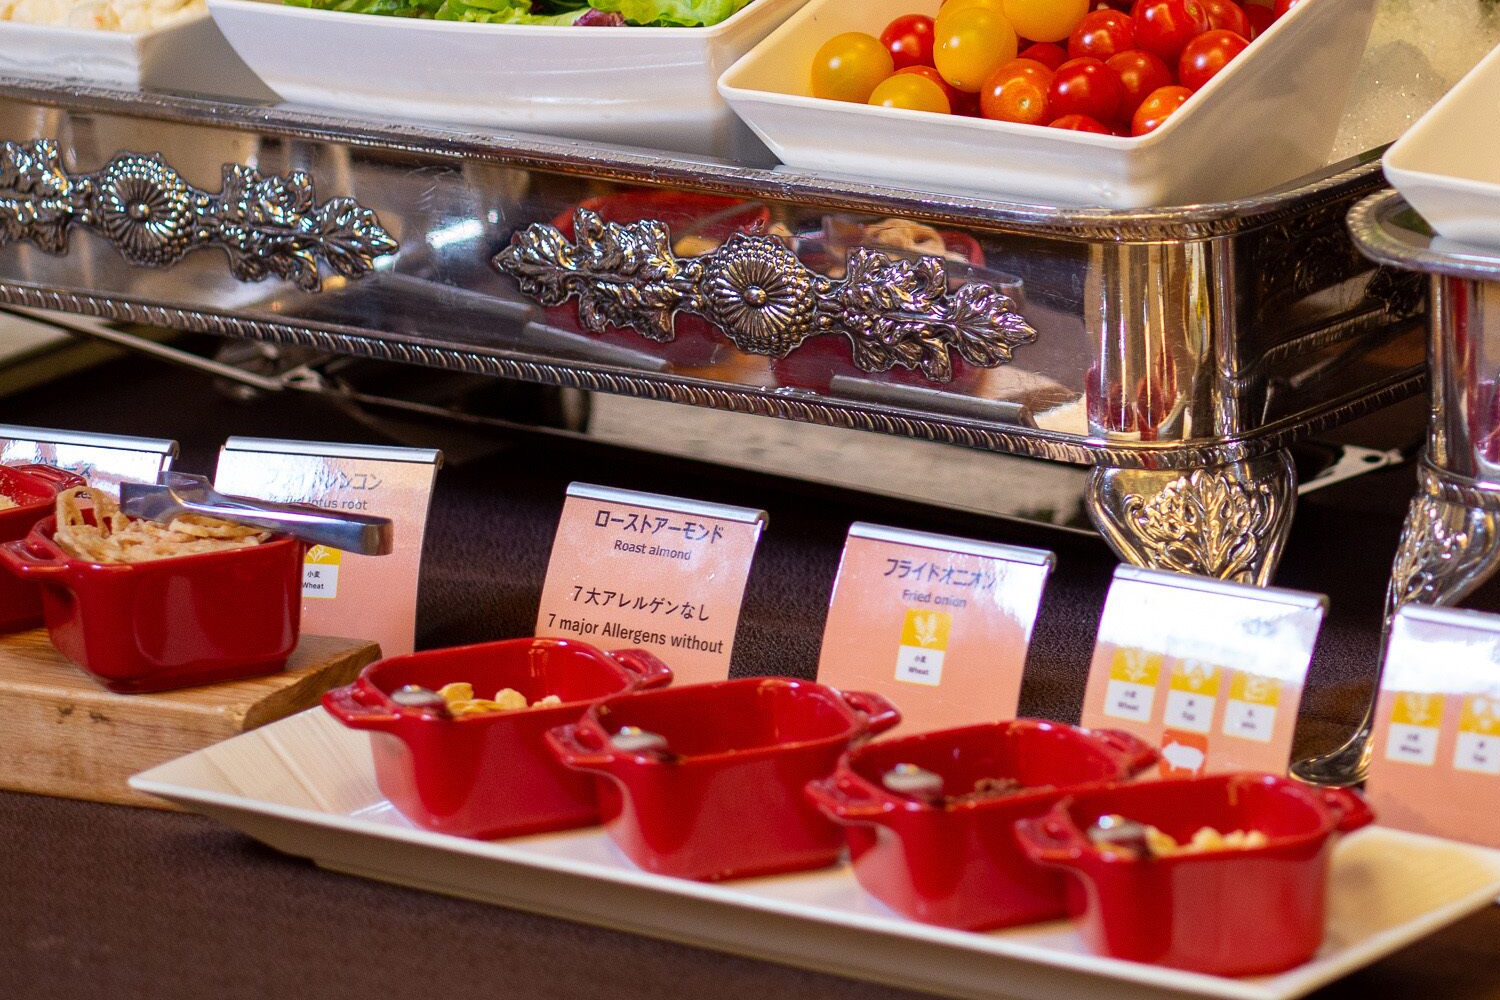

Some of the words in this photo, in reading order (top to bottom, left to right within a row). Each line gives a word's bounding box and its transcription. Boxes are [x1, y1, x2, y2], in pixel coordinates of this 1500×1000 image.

[342, 499, 368, 511] root
[595, 510, 725, 544] ローストアーモンド
[614, 539, 647, 555] Roast
[648, 547, 692, 561] almond
[902, 589, 931, 604] Fried
[934, 595, 967, 608] onion
[548, 613, 557, 628] 7
[559, 618, 600, 636] major
[602, 622, 667, 645] Allergens
[671, 634, 724, 654] without
